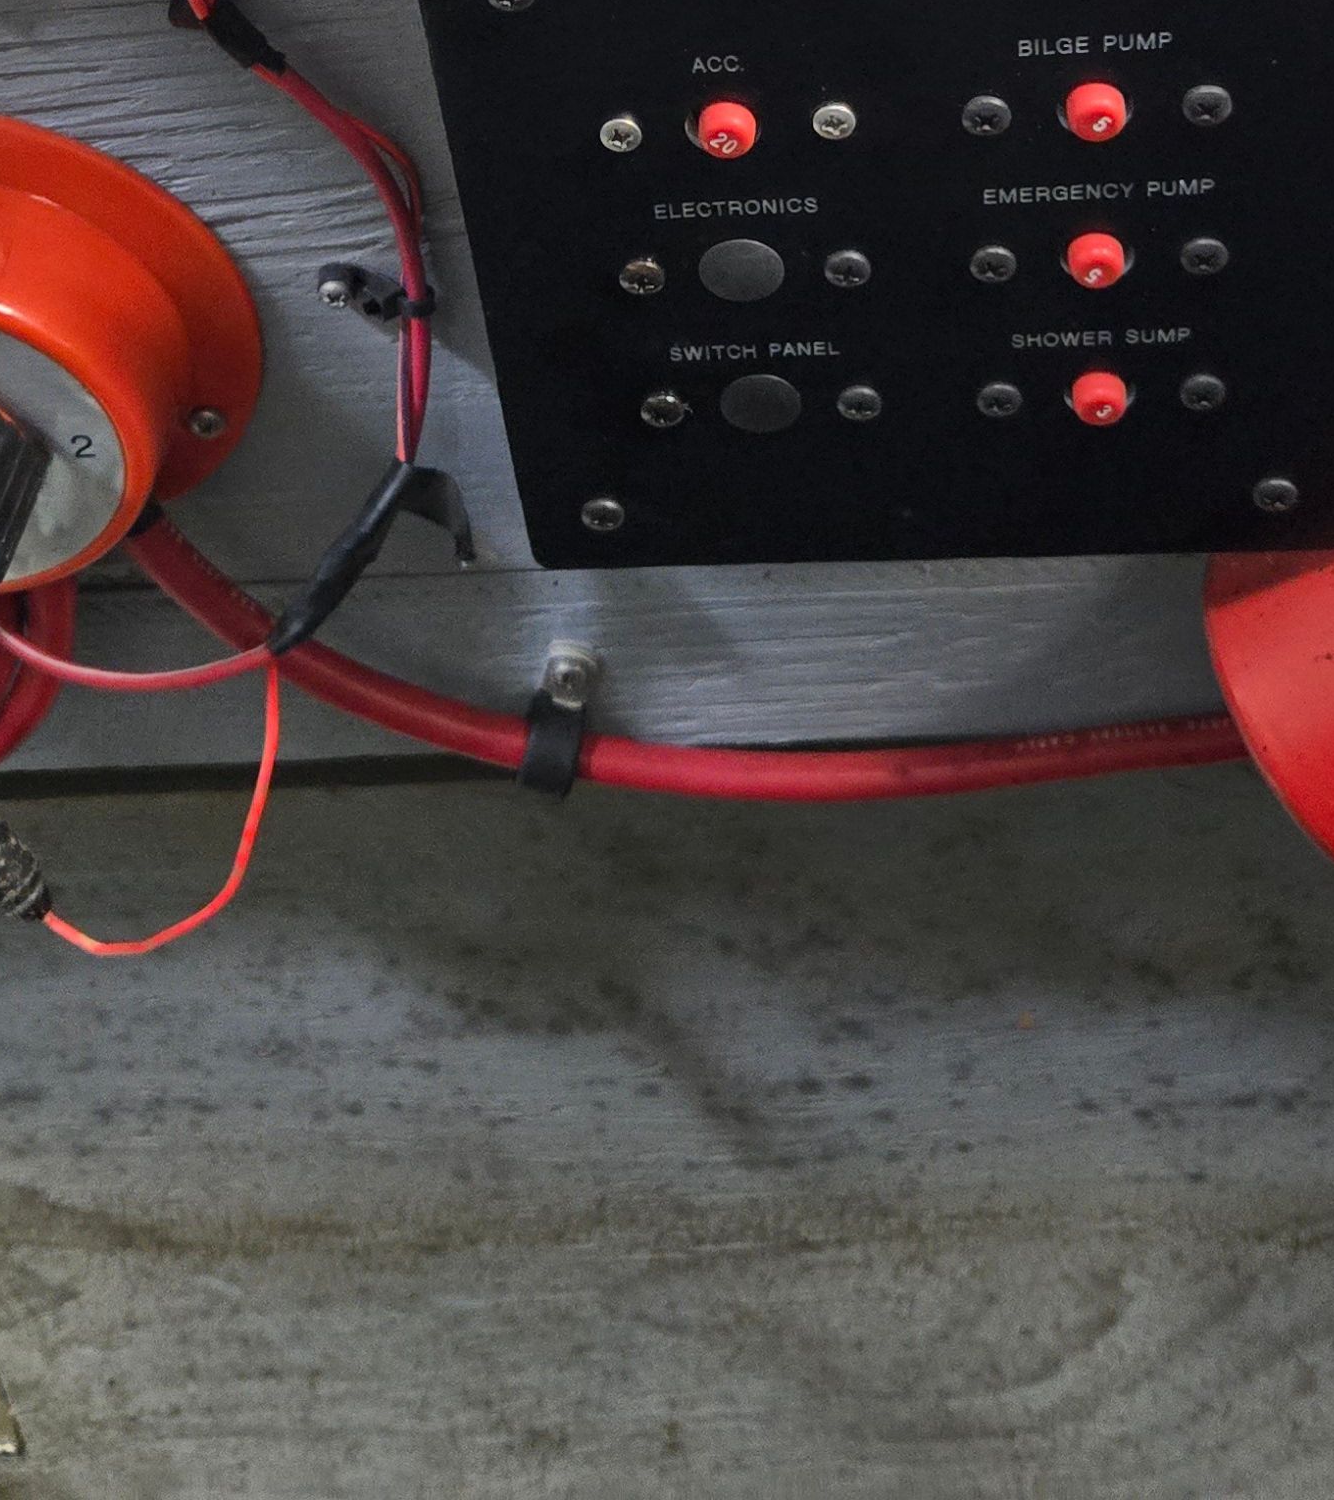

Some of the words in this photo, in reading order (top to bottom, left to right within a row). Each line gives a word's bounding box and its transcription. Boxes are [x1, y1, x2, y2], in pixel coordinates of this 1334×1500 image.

[1018, 36, 1089, 57] BILGE
[1103, 32, 1173, 53] PUMP
[692, 55, 745, 74] ACC.
[709, 132, 738, 155] 20
[983, 183, 1134, 205] EMERGENCY
[1147, 178, 1216, 197] PUMP
[654, 197, 819, 220] ELECTRONICS
[1012, 331, 1113, 349] SHOWER
[1125, 328, 1191, 345] SUMP
[670, 345, 757, 362] SWITCH
[769, 342, 841, 358] PANEL
[70, 434, 97, 459] 2
